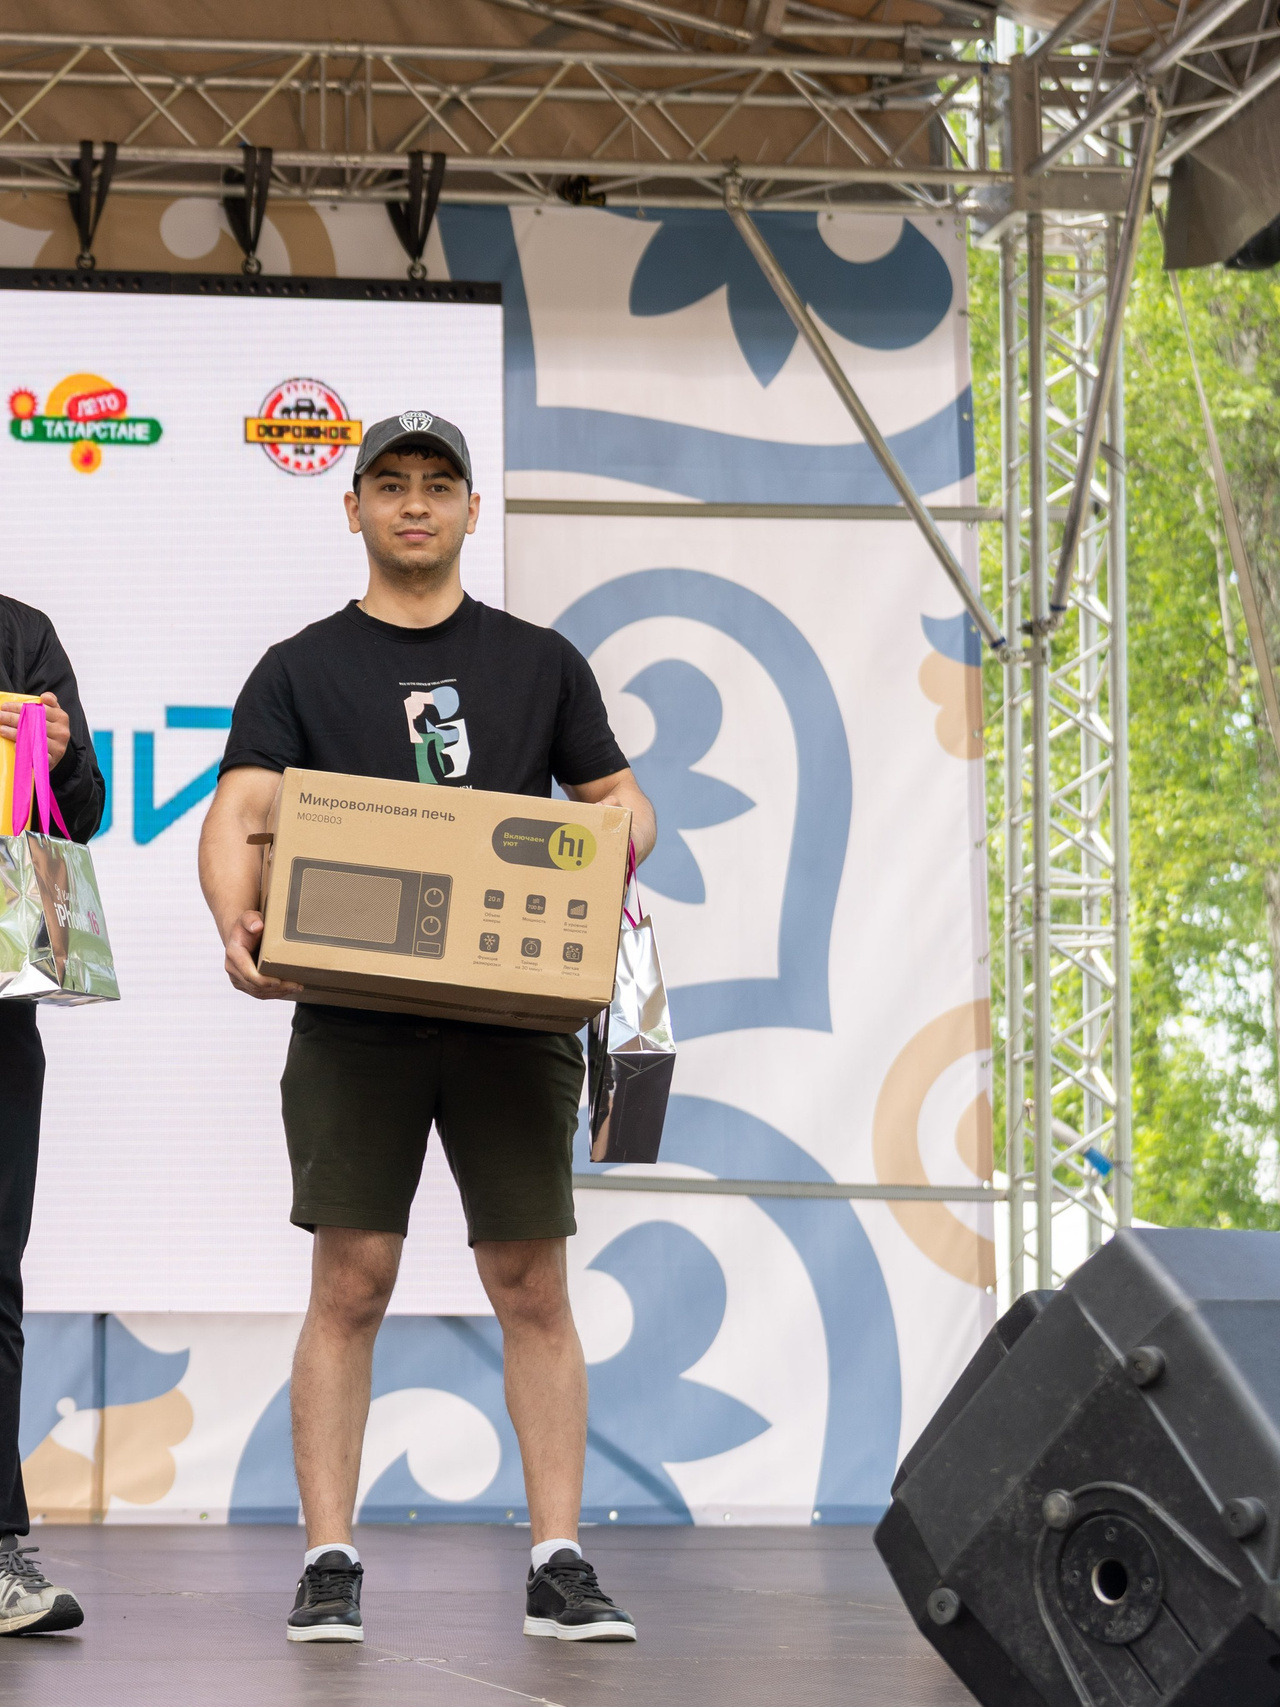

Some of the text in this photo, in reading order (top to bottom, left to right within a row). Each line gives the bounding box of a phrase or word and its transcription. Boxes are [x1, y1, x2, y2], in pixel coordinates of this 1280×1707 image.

[76, 393, 120, 418] ЛЕТО
[20, 420, 151, 442] В ТАТАРСТАНЕ
[257, 424, 352, 441] ДОРОЖНОЕ
[299, 791, 456, 823] Микроволновая печь
[503, 831, 545, 844] Включаем
[53, 901, 100, 936] iPhone 16
